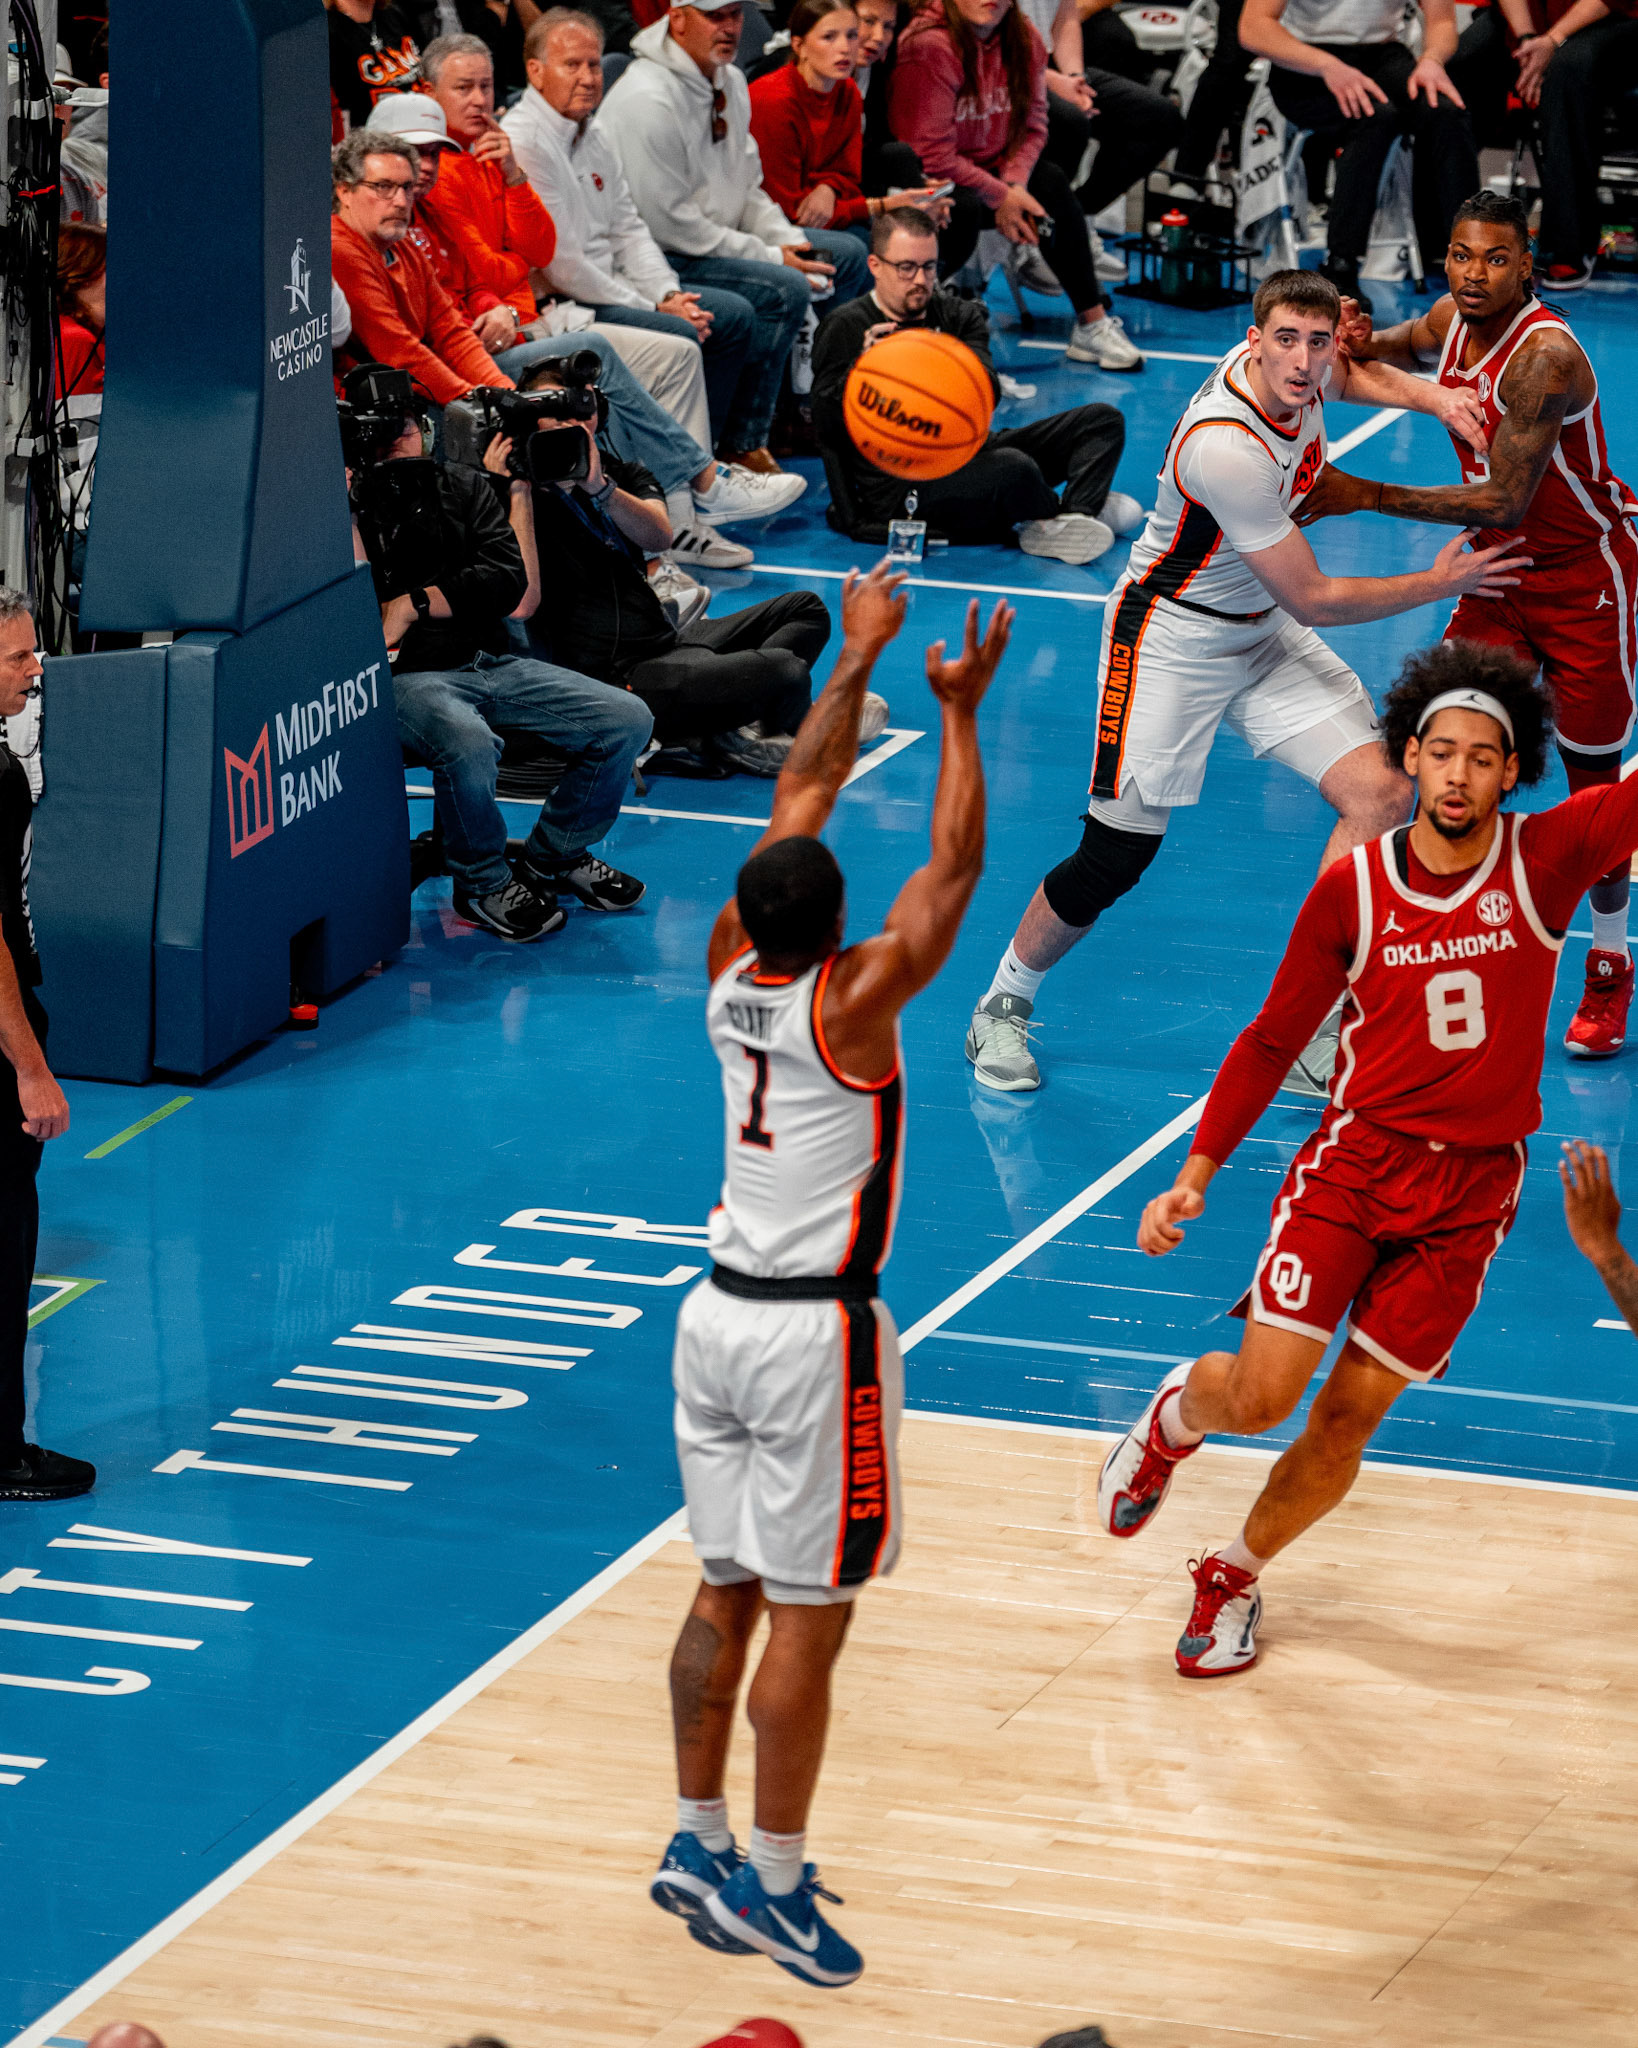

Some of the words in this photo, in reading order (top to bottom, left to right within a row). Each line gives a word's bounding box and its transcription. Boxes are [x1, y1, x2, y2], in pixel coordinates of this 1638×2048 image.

[270, 313, 328, 362] NEWCASTLE
[278, 343, 322, 381] CASINO
[857, 379, 942, 439] Wilson
[1100, 642, 1132, 745] COWBOYS
[1478, 892, 1511, 924] SEC
[1382, 929, 1518, 966] OKLAHOMA
[1424, 968, 1488, 1052] 8
[740, 1044, 774, 1152] 1
[1269, 1251, 1312, 1311] OU
[152, 1207, 711, 1491] THUNDER
[850, 1385, 883, 1520] COWBOYS
